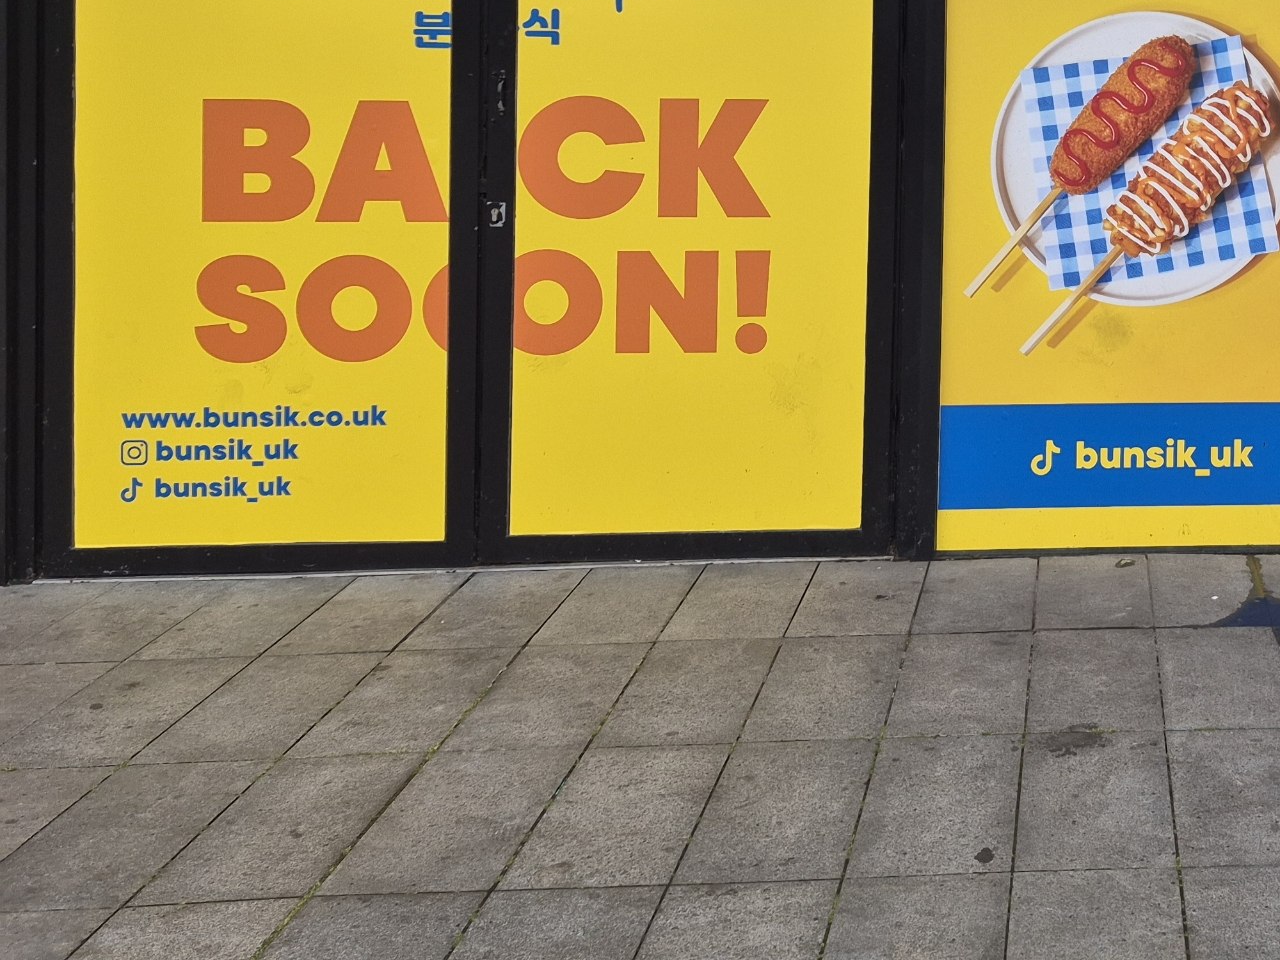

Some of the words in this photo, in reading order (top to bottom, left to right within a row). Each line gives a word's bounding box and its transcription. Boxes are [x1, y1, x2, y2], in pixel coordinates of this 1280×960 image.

[202, 96, 771, 222] BACK
[194, 249, 771, 363] SOON!
[121, 405, 387, 429] www.bunsik.co.uk
[155, 438, 299, 467] bunsik_uk
[1075, 438, 1253, 476] bunsik_uk
[154, 475, 292, 503] bunsik_uk
